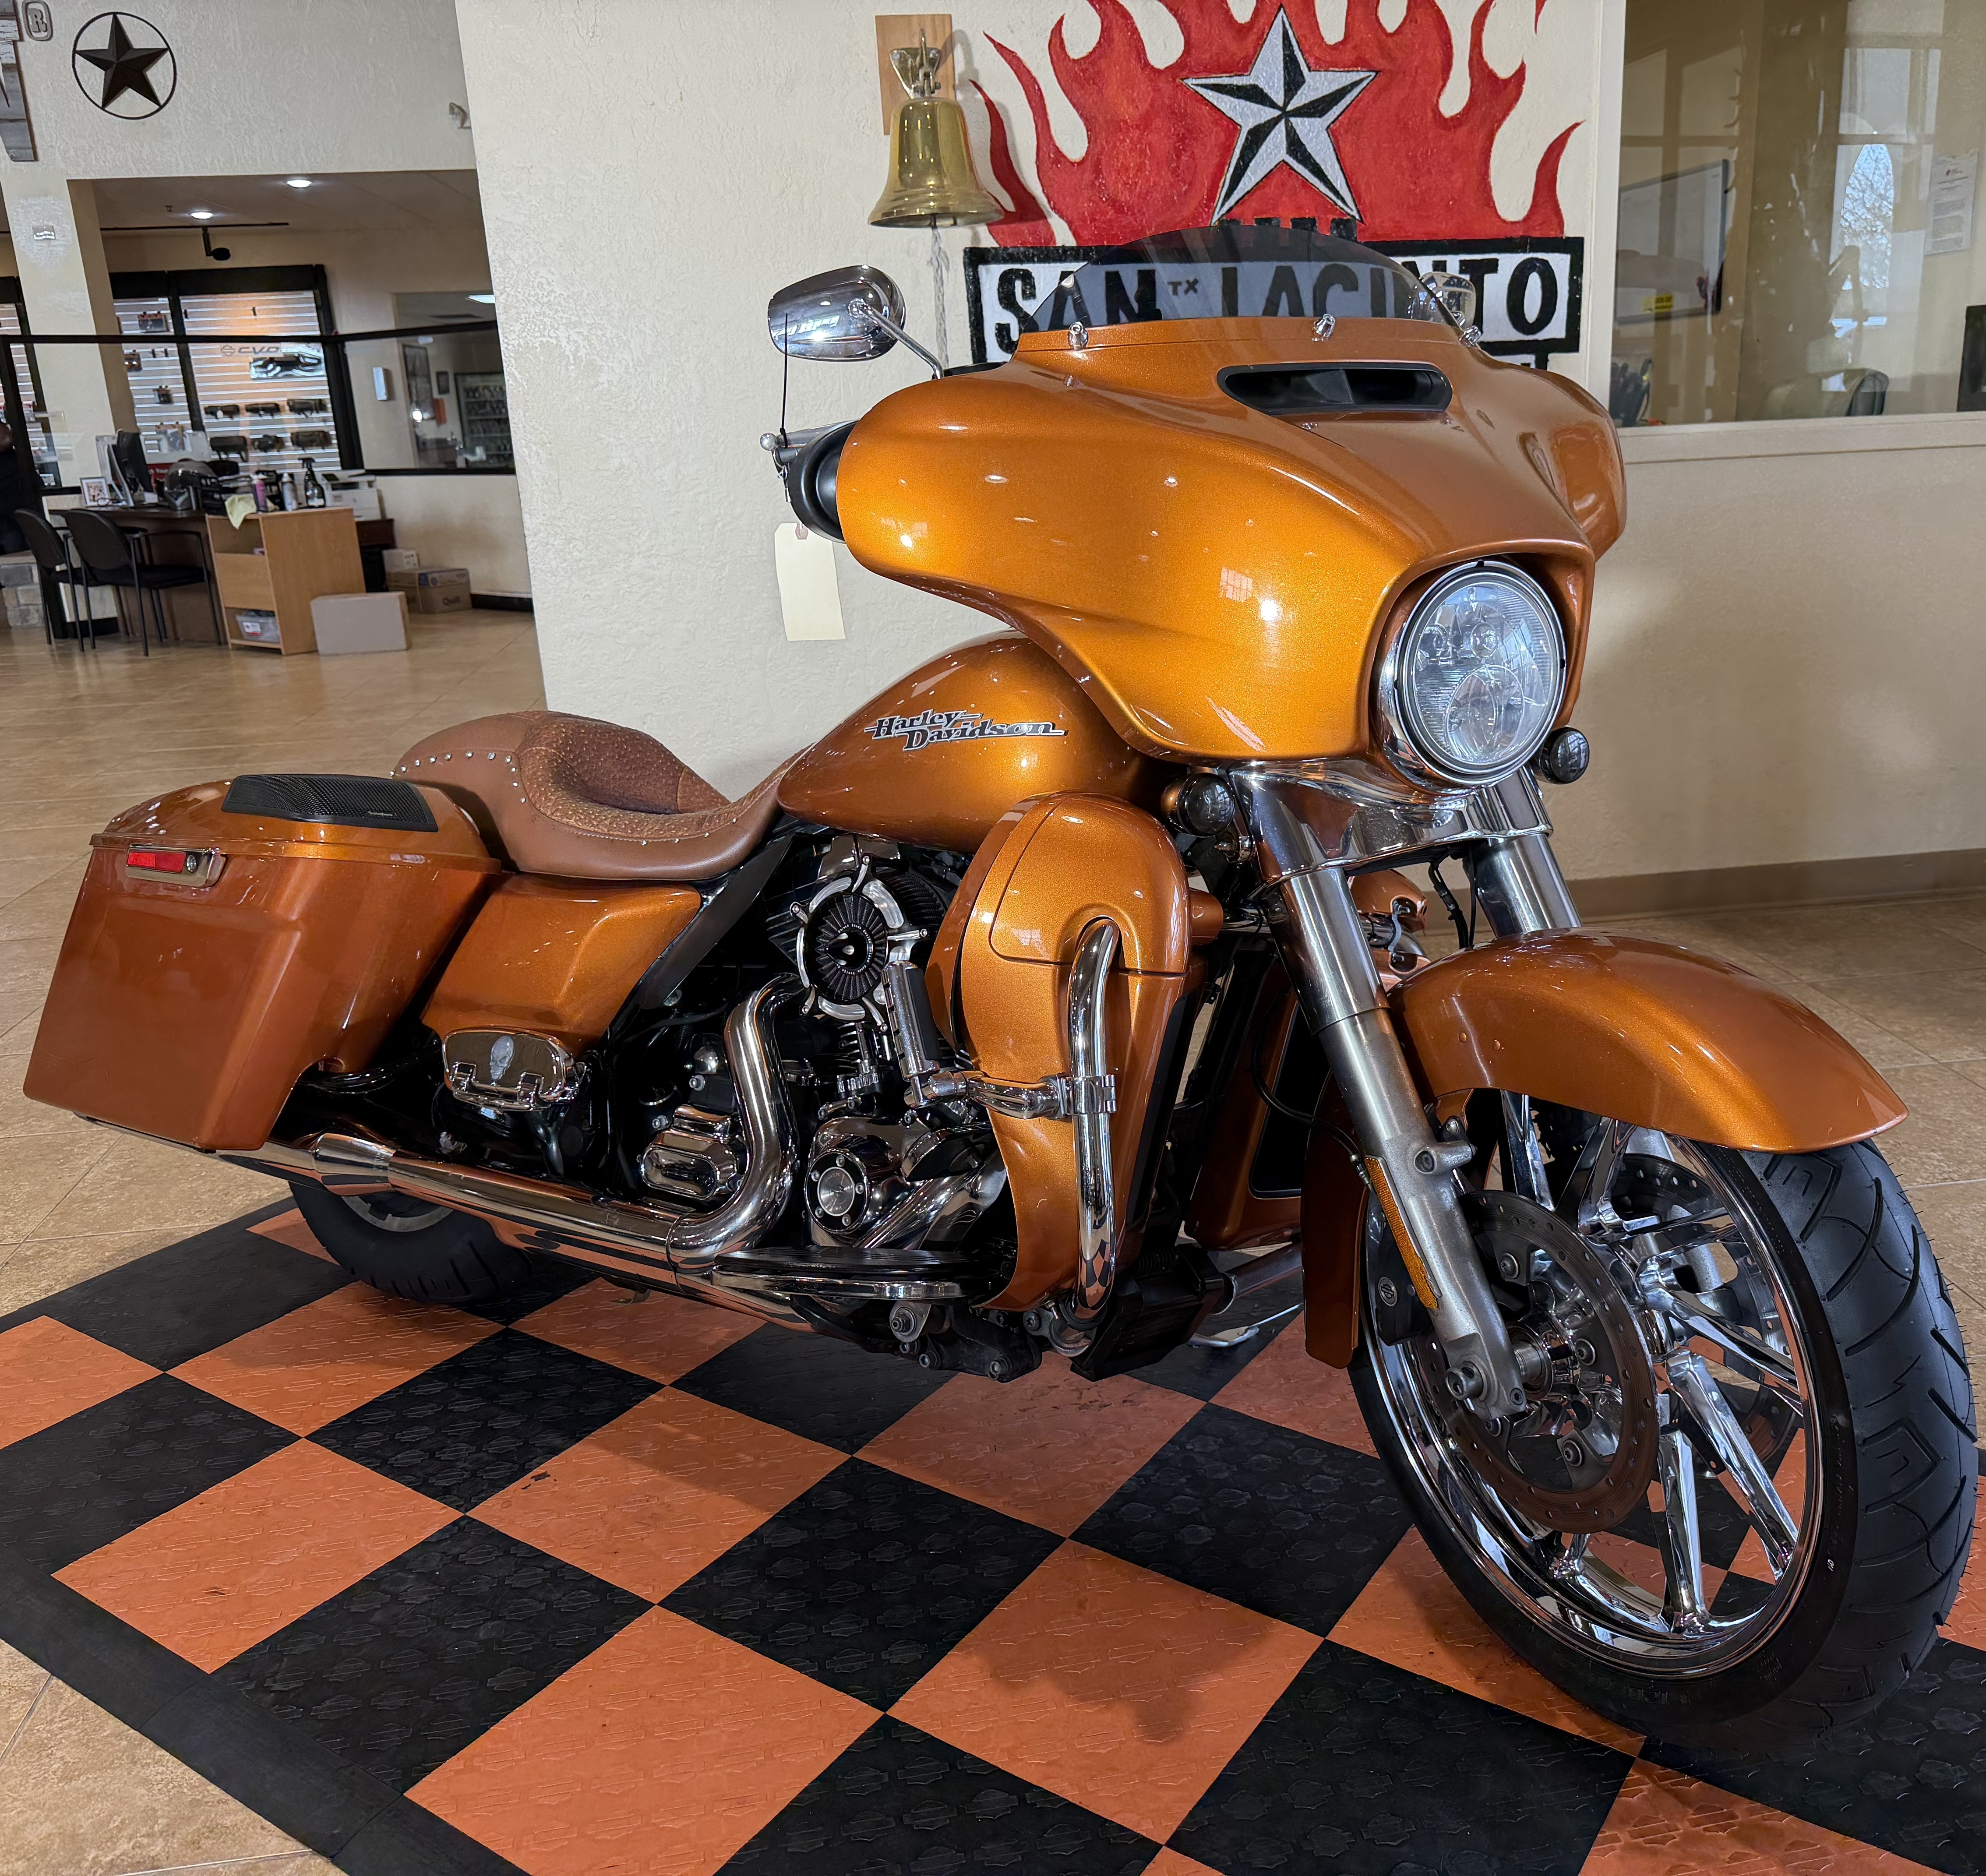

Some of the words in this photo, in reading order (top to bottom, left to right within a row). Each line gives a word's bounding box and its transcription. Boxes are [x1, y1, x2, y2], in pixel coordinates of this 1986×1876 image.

[997, 268, 1156, 354] SAN
[1168, 278, 1199, 296] TX
[238, 346, 279, 355] CVO
[896, 716, 1069, 751] Davidson
